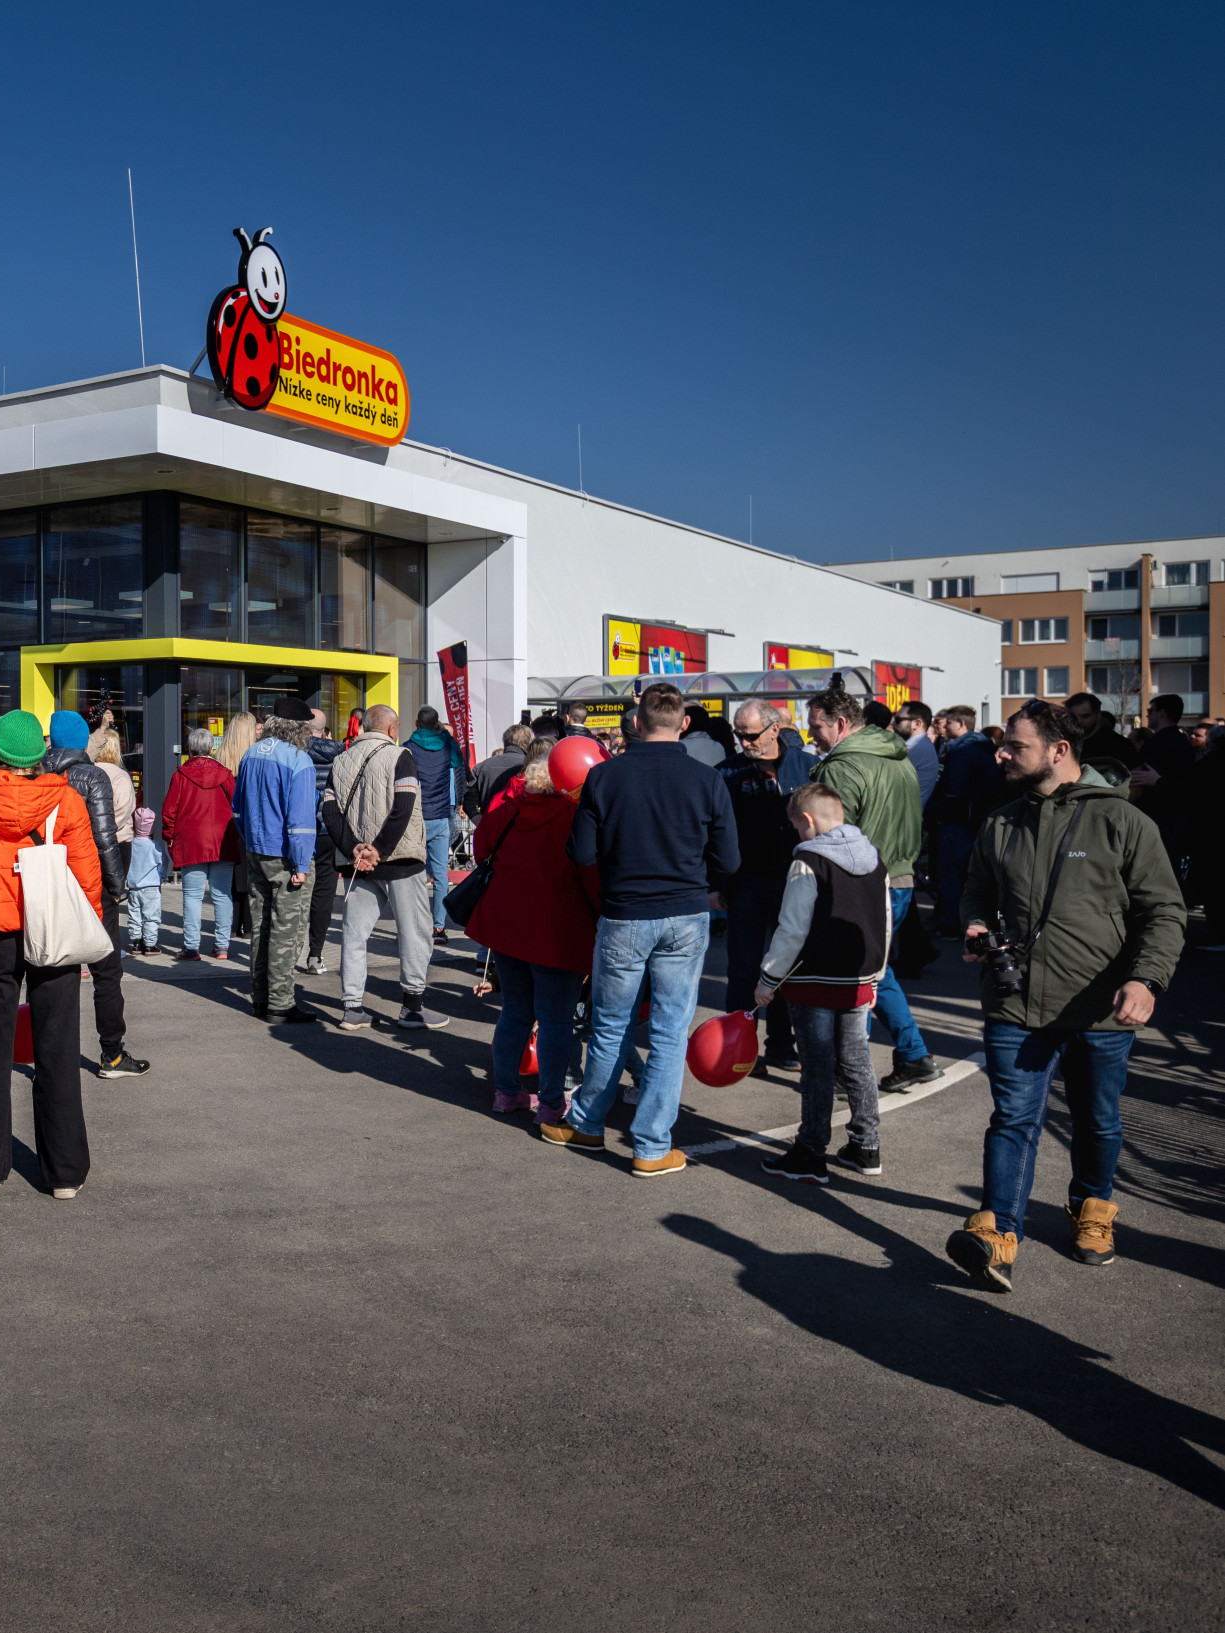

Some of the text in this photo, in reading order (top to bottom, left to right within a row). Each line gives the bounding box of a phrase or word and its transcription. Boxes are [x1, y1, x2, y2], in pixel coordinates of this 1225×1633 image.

[279, 331, 398, 407] Biedronka
[279, 375, 398, 428] Nízke ceny každý deň
[595, 703, 624, 711] TÝŽDEŇ
